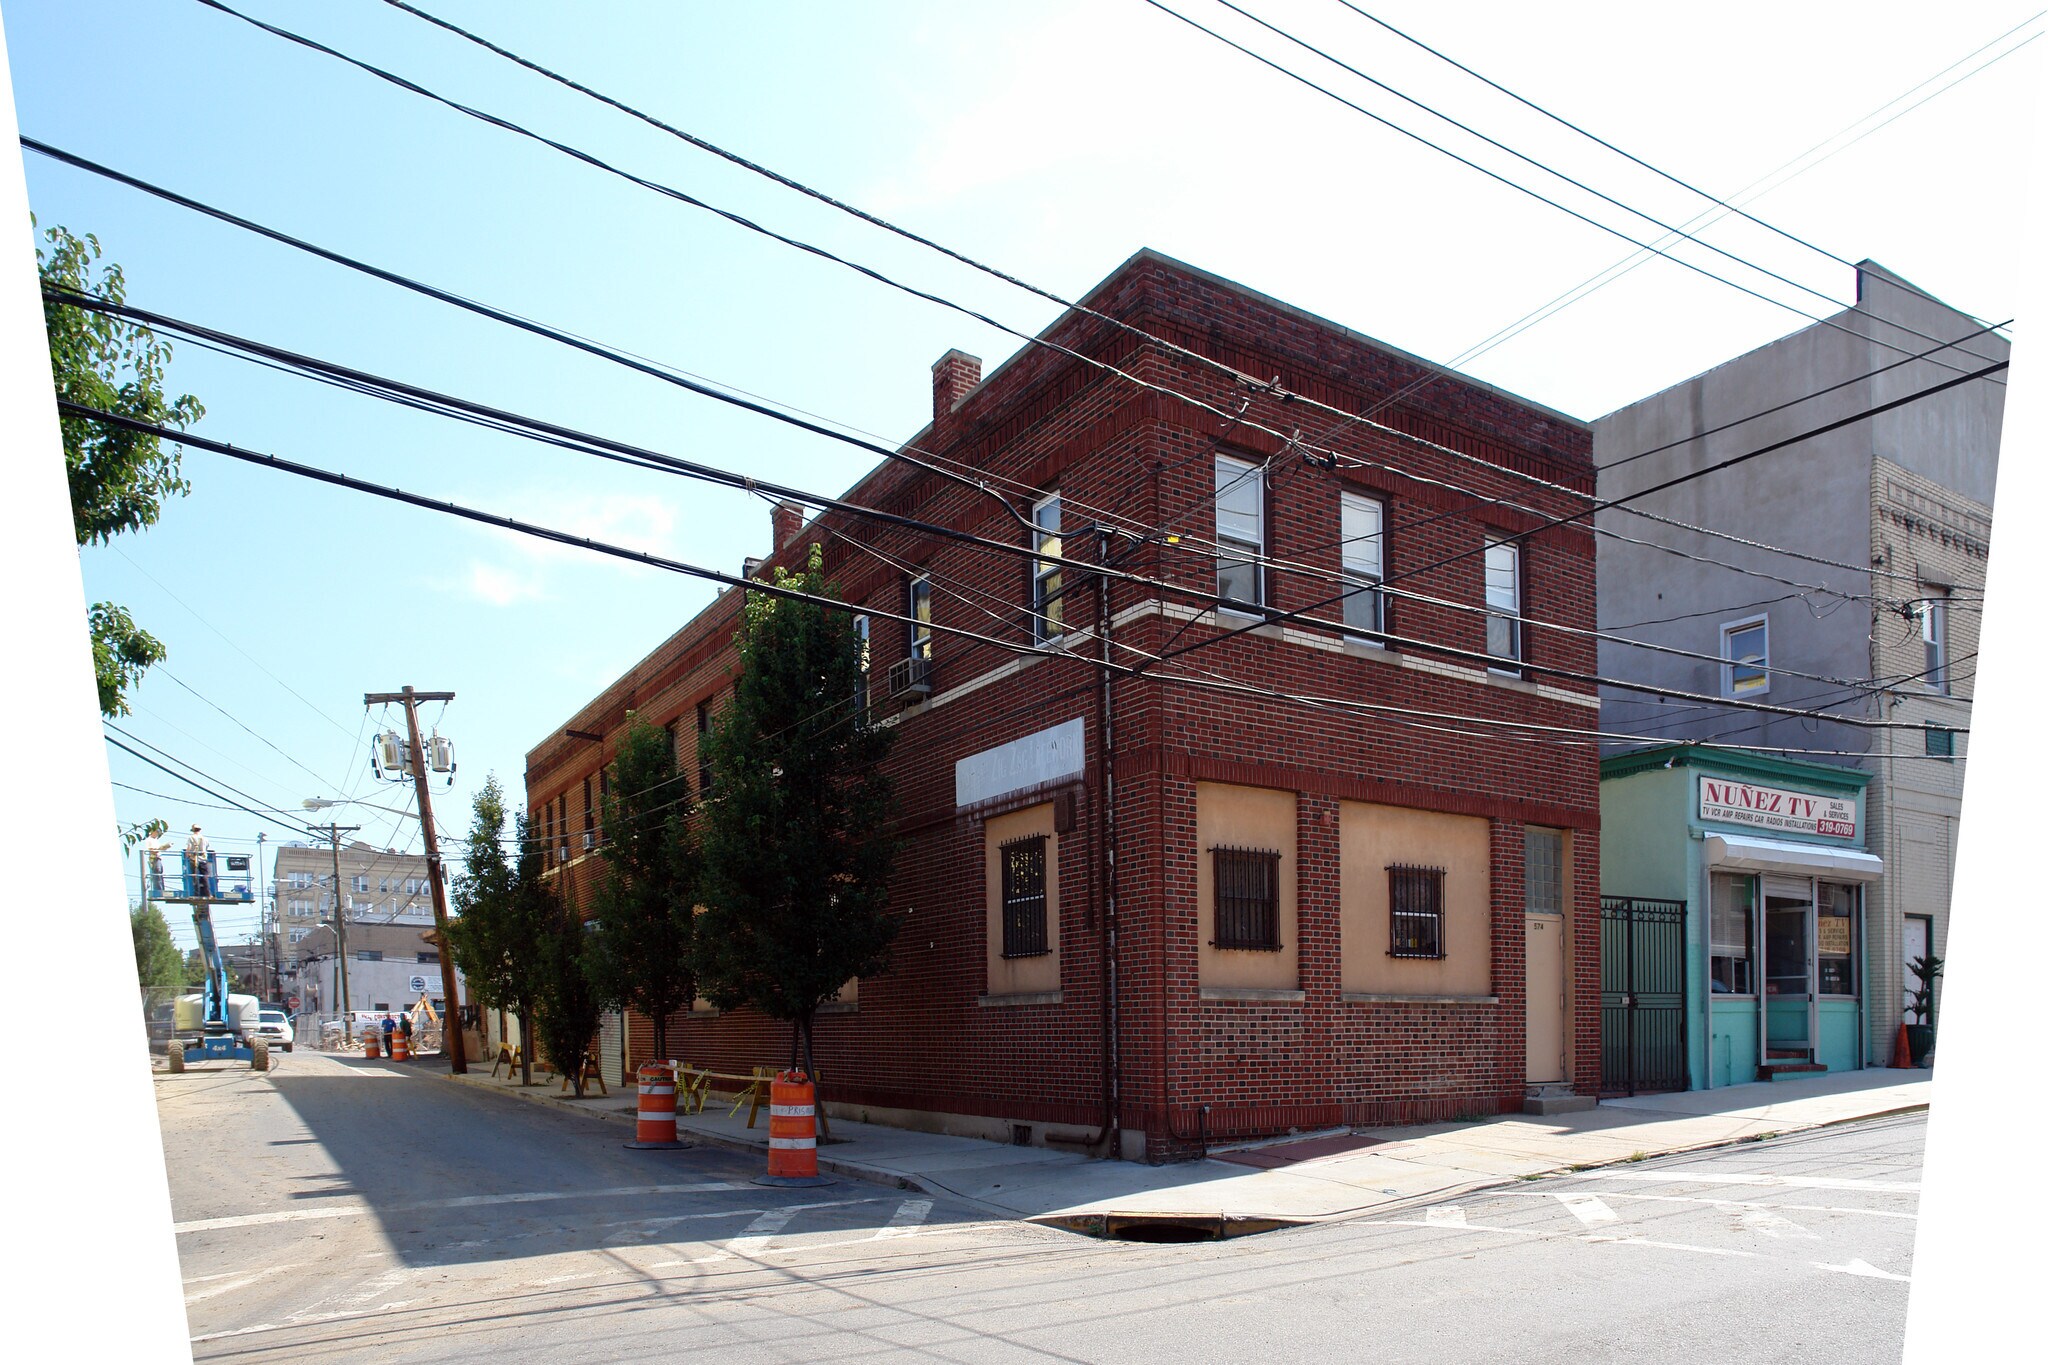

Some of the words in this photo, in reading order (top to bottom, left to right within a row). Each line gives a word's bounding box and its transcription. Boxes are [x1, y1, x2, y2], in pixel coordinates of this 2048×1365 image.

[1705, 782, 1782, 813] NUÑEZ
[1789, 797, 1818, 817] TV
[1830, 801, 1844, 811] SALES
[1703, 806, 1709, 815] TV
[1711, 808, 1721, 816] VCR
[1722, 810, 1733, 818] AMP
[1735, 811, 1754, 821] REPAIRS
[1755, 815, 1764, 823] CAR
[1766, 816, 1783, 826] RADIOS
[1784, 819, 1817, 831] INSTALLATIONS
[1824, 810, 1827, 818] &
[1828, 811, 1849, 820] SERVICES
[1819, 820, 1853, 835] 319-0769
[1534, 922, 1544, 931] 574
